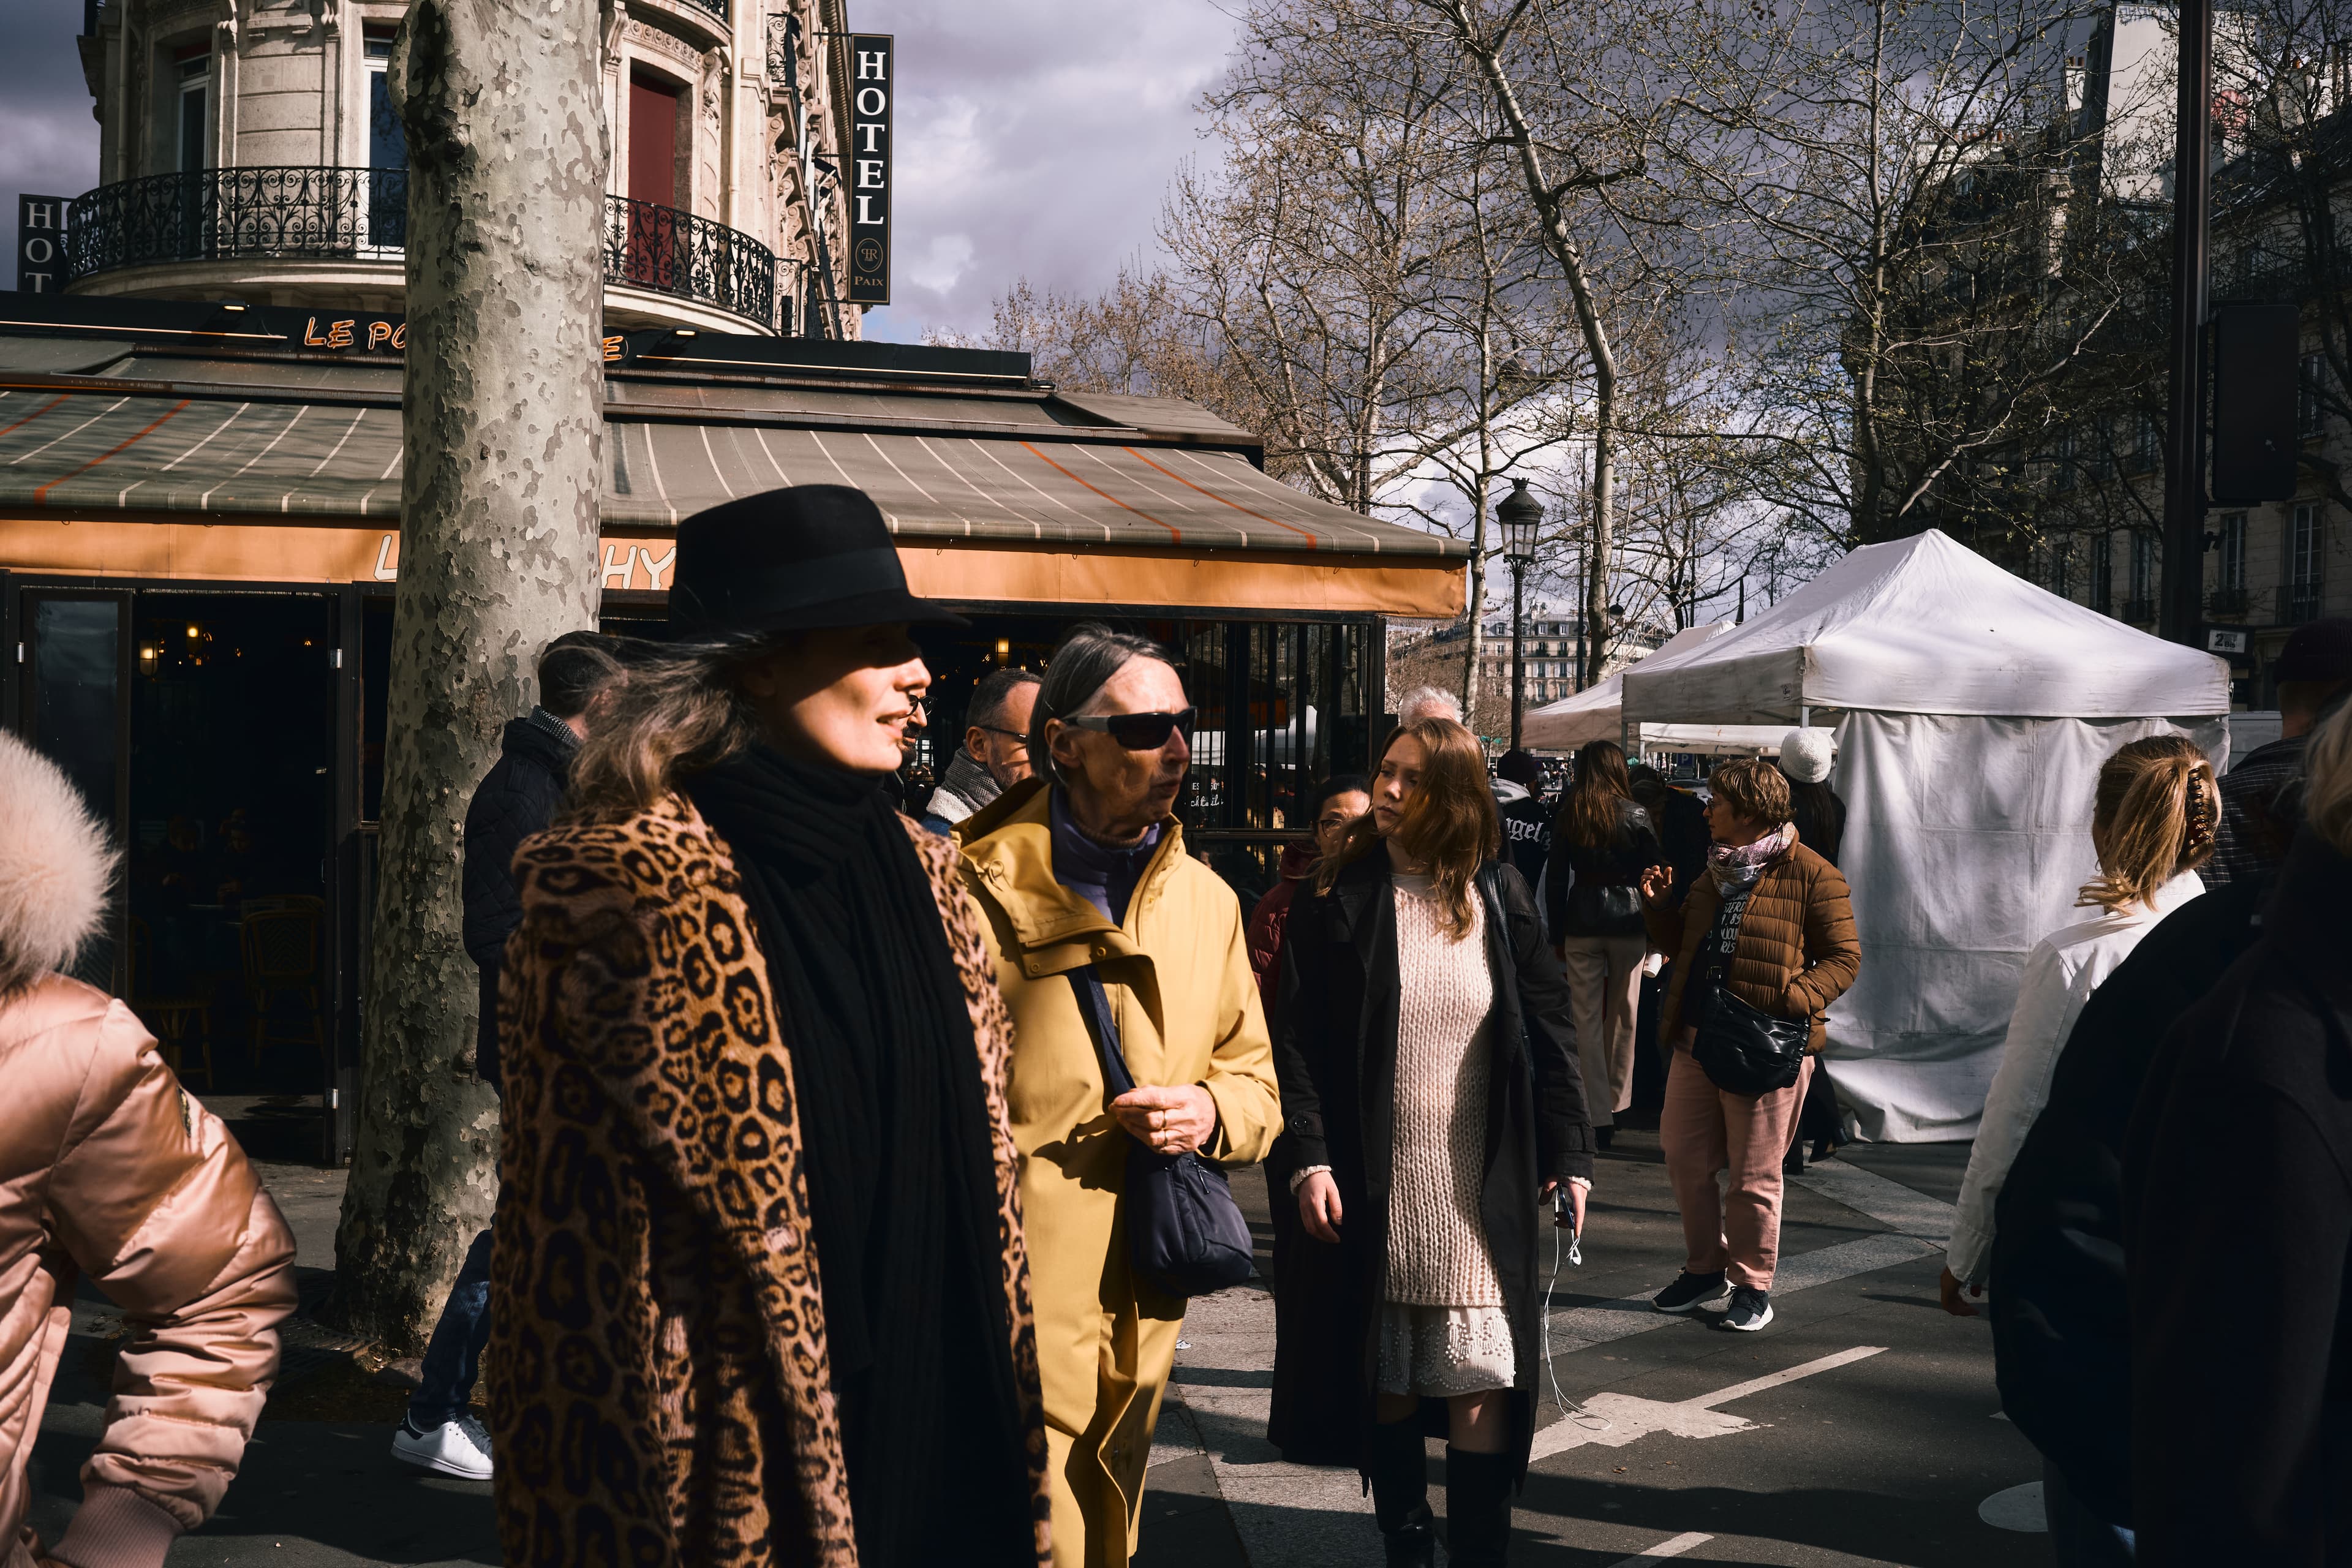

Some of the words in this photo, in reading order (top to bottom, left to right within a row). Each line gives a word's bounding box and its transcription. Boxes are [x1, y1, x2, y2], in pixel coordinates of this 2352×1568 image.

[856, 51, 886, 225] HOTEL
[25, 202, 53, 293] HOT
[304, 316, 355, 349] LE
[1681, 754, 1689, 764] P
